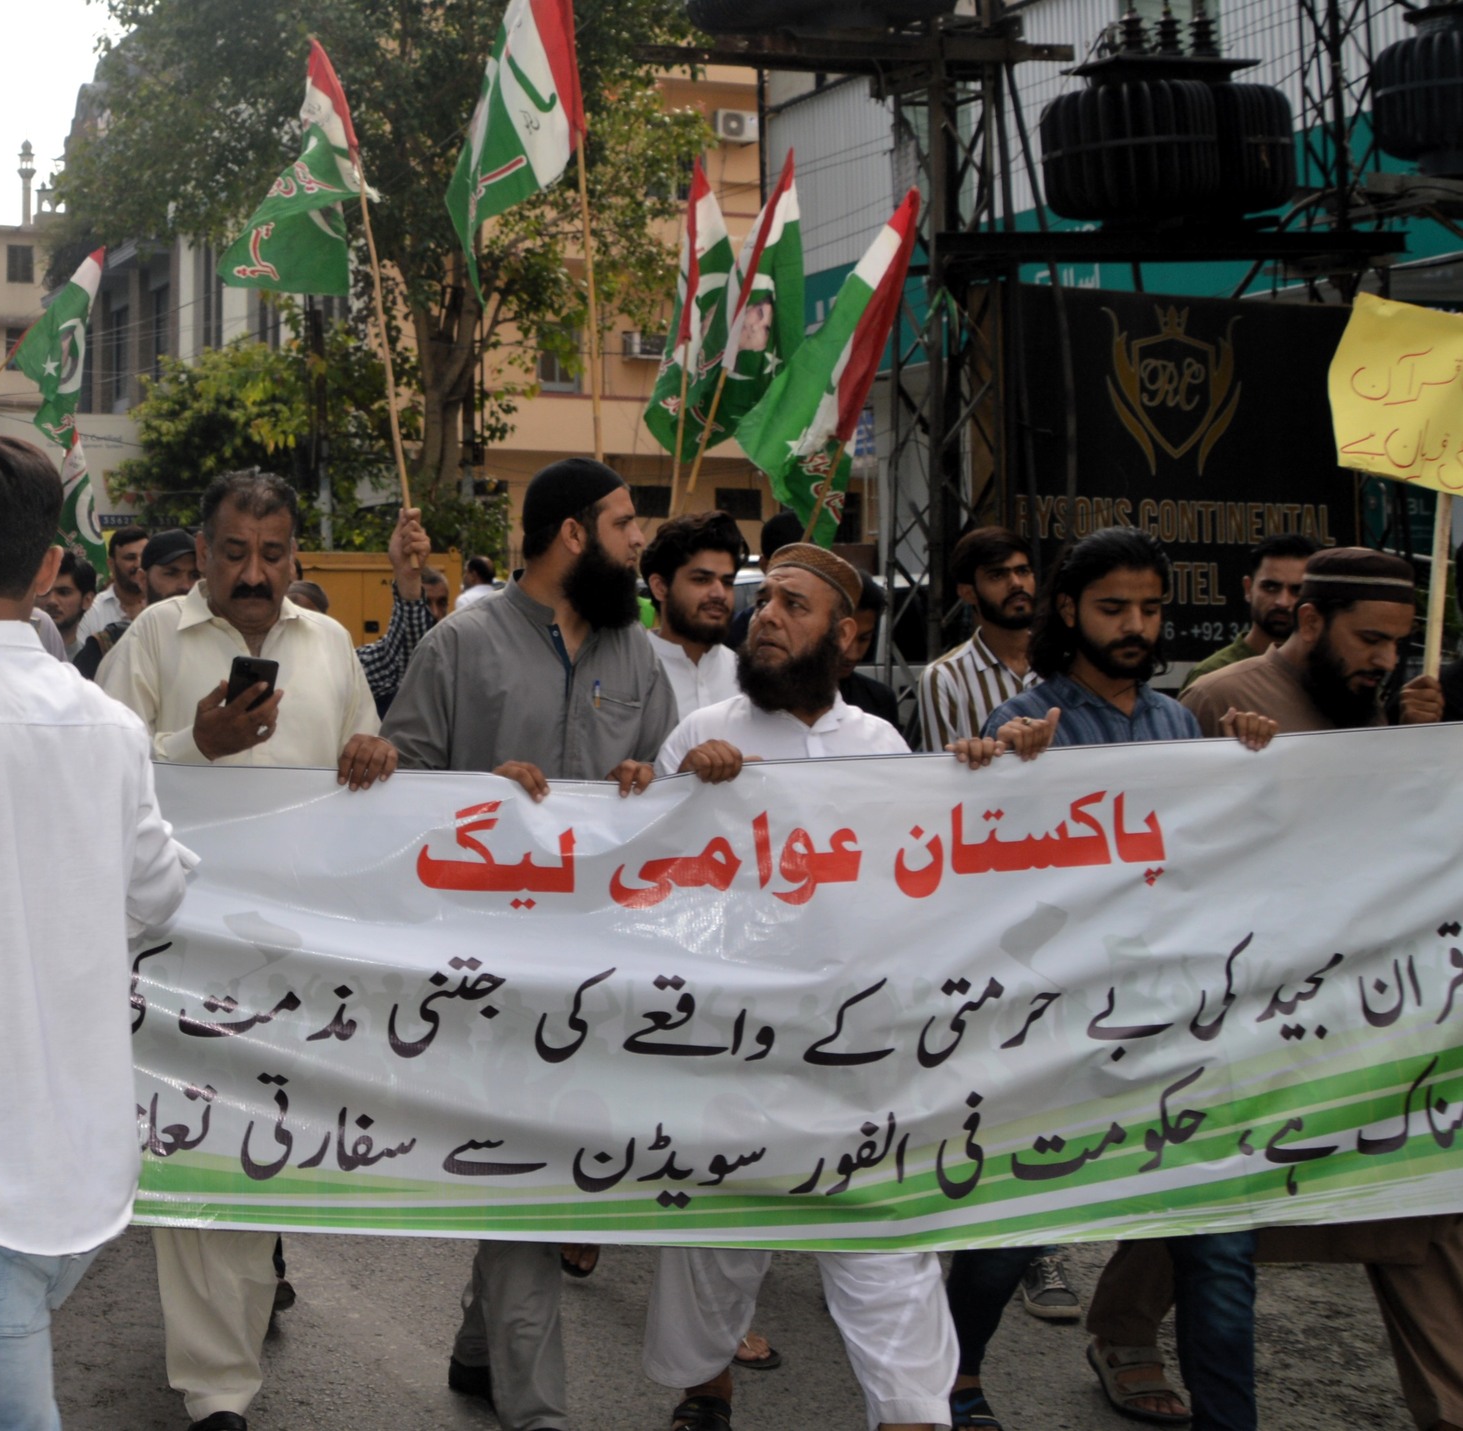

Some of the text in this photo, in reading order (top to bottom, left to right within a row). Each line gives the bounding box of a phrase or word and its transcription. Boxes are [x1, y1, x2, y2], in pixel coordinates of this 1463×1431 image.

[1138, 498, 1337, 547] CONTINENTAL
[1162, 561, 1229, 606] OTEL
[416, 790, 1167, 910] پاکستان عوامی لیگ
[178, 985, 357, 1041] مذمت
[387, 956, 506, 1058] جتنی
[536, 967, 616, 1062] کی
[622, 974, 775, 1062] واقعے
[803, 978, 896, 1066] کے
[1086, 986, 1174, 1062] بے
[1189, 932, 1254, 1040] کی
[1256, 953, 1344, 1041] مجید
[241, 1072, 417, 1181] سفارتی
[442, 1137, 547, 1175] سے
[572, 1123, 767, 1209] سویڈن
[789, 1110, 911, 1196] الفور
[936, 1091, 984, 1199] فی
[1011, 1066, 1207, 1181] حکومت
